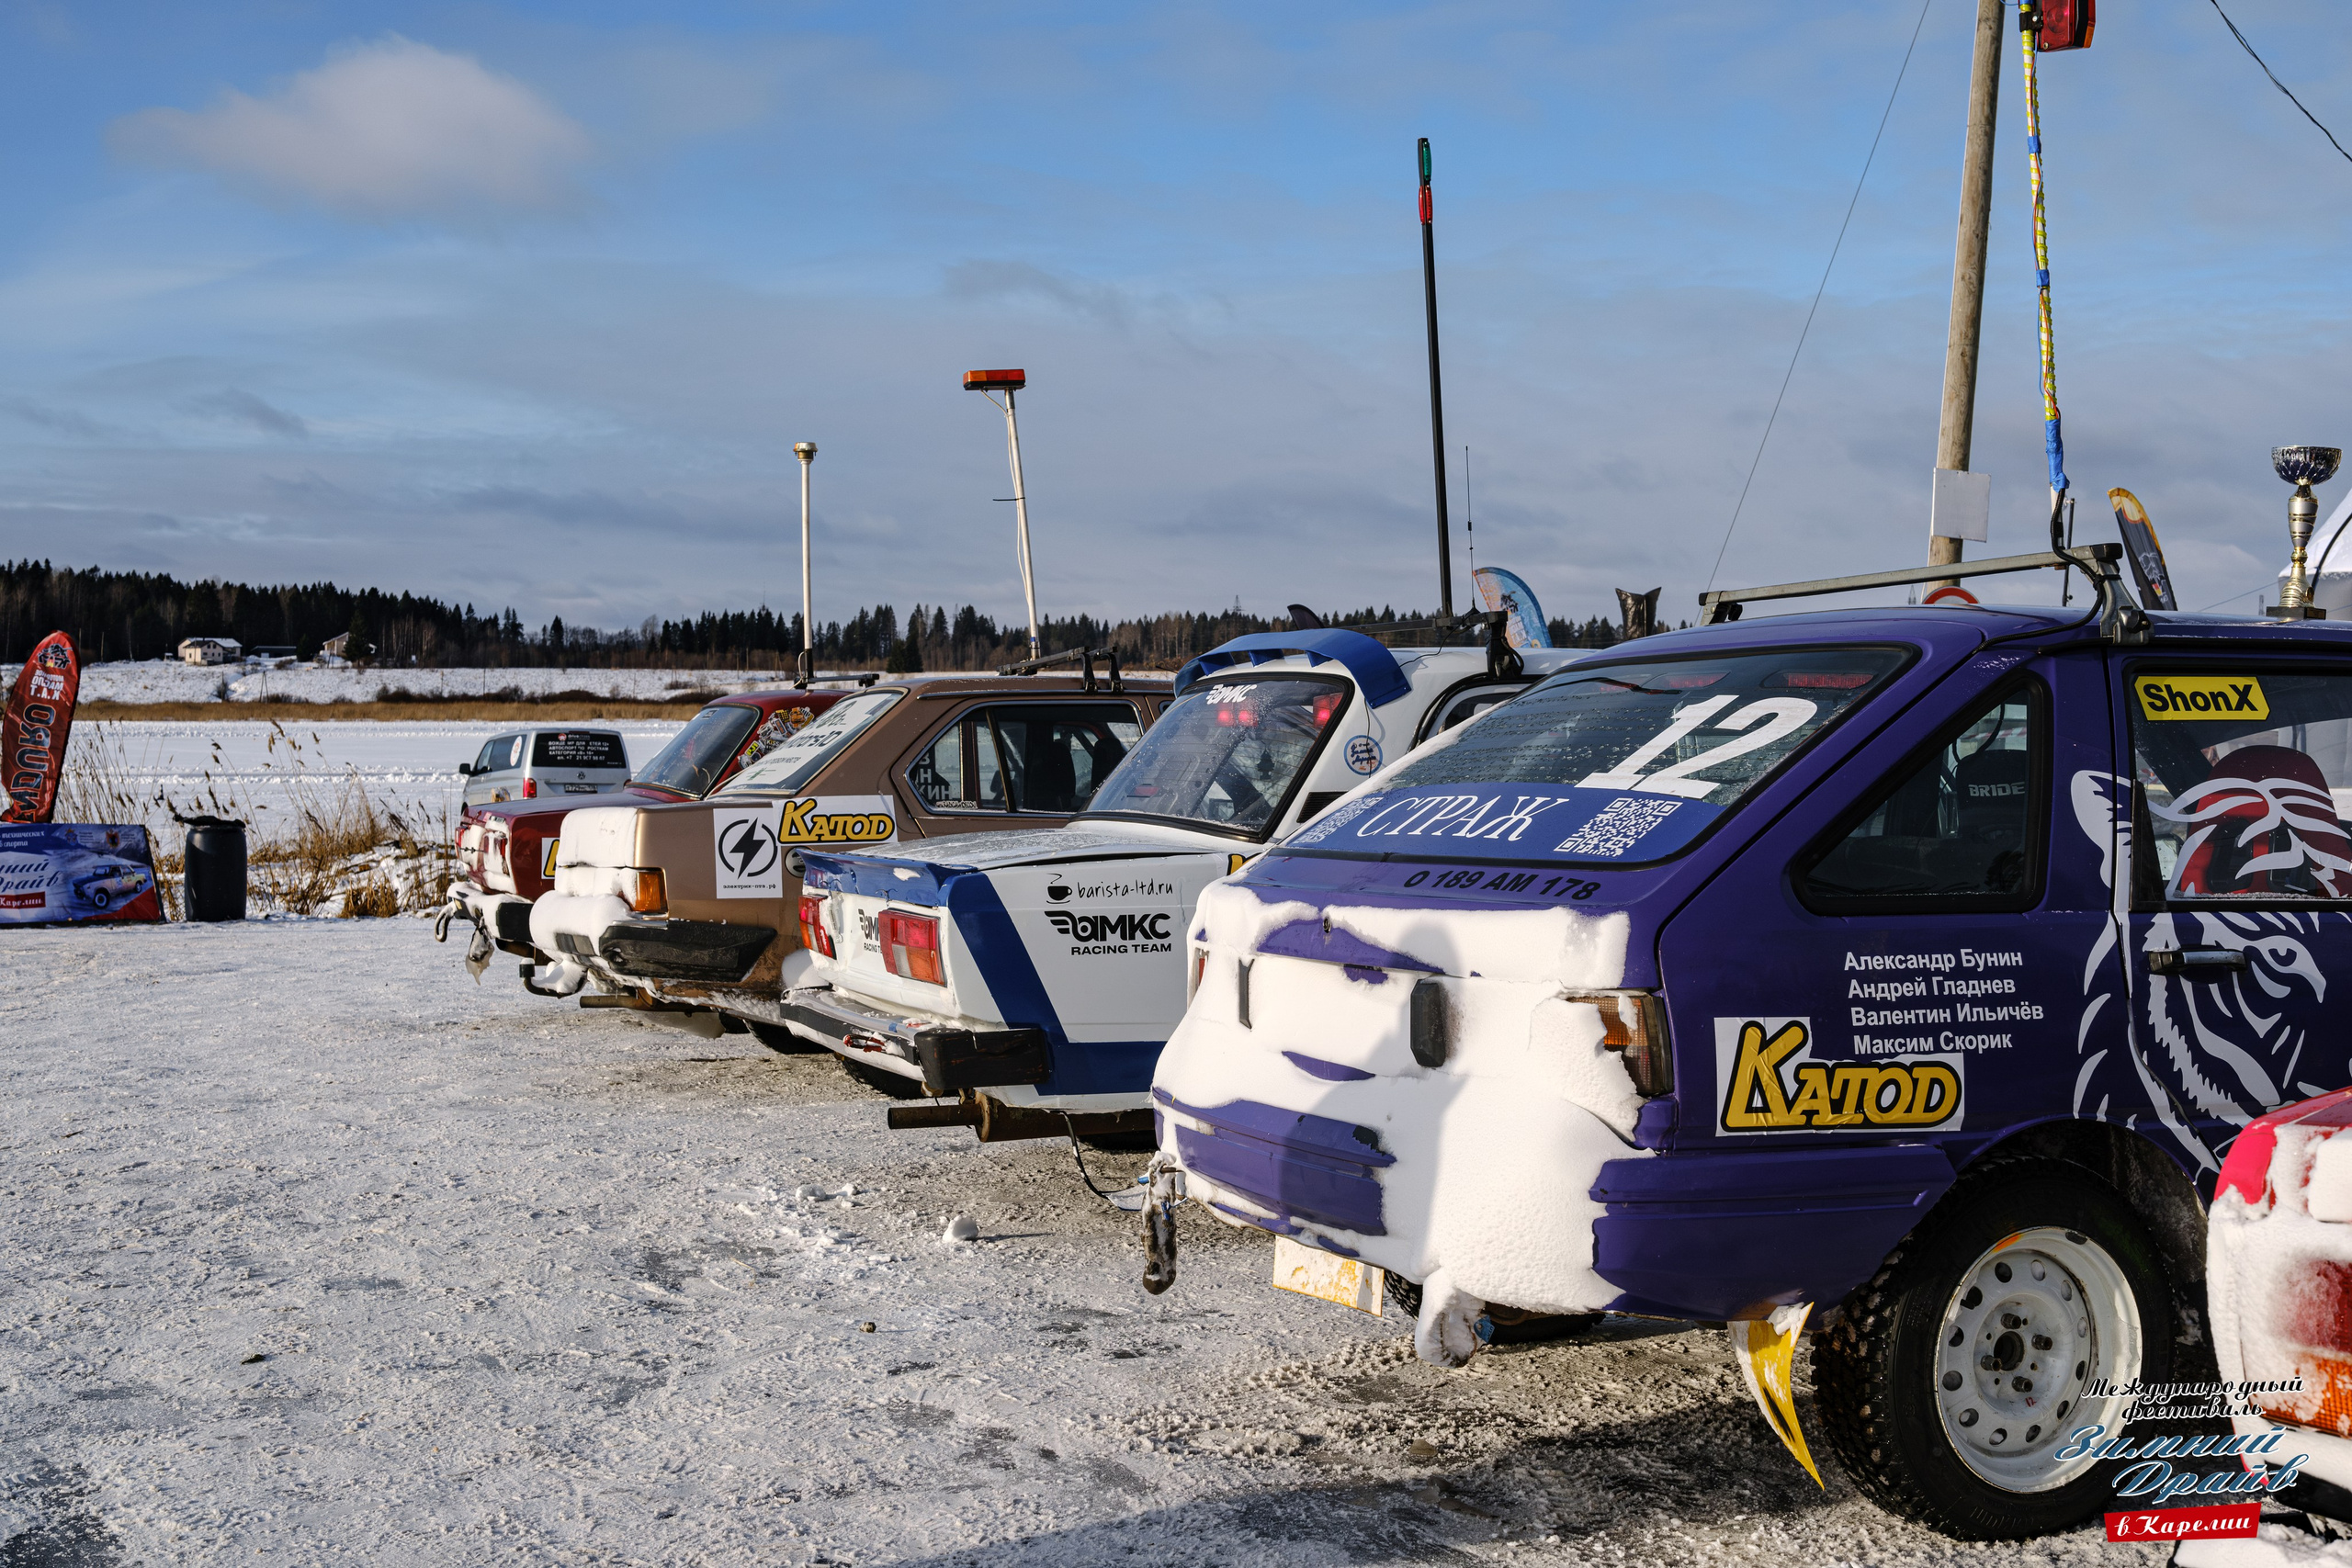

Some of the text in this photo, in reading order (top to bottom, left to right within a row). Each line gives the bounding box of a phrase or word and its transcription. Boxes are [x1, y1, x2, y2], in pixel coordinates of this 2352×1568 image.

[2147, 683, 2259, 712] ShonX
[1575, 694, 1818, 799] 12
[1968, 782, 2025, 796] BRIDE
[1356, 795, 1570, 841] СТРАЖ
[1077, 878, 1174, 898] barista-ltd.ru
[1431, 871, 1486, 888] 189
[1480, 873, 1539, 893] АМ
[1539, 876, 1601, 900] 178
[1071, 943, 1172, 955] RACING TEAM
[1845, 948, 2023, 972] Александр Бунин
[1848, 976, 2016, 1001] Андрей Гладнев
[1851, 1001, 2044, 1026] Валентин Ильичёв
[1854, 1031, 2013, 1055] Максим Скорик
